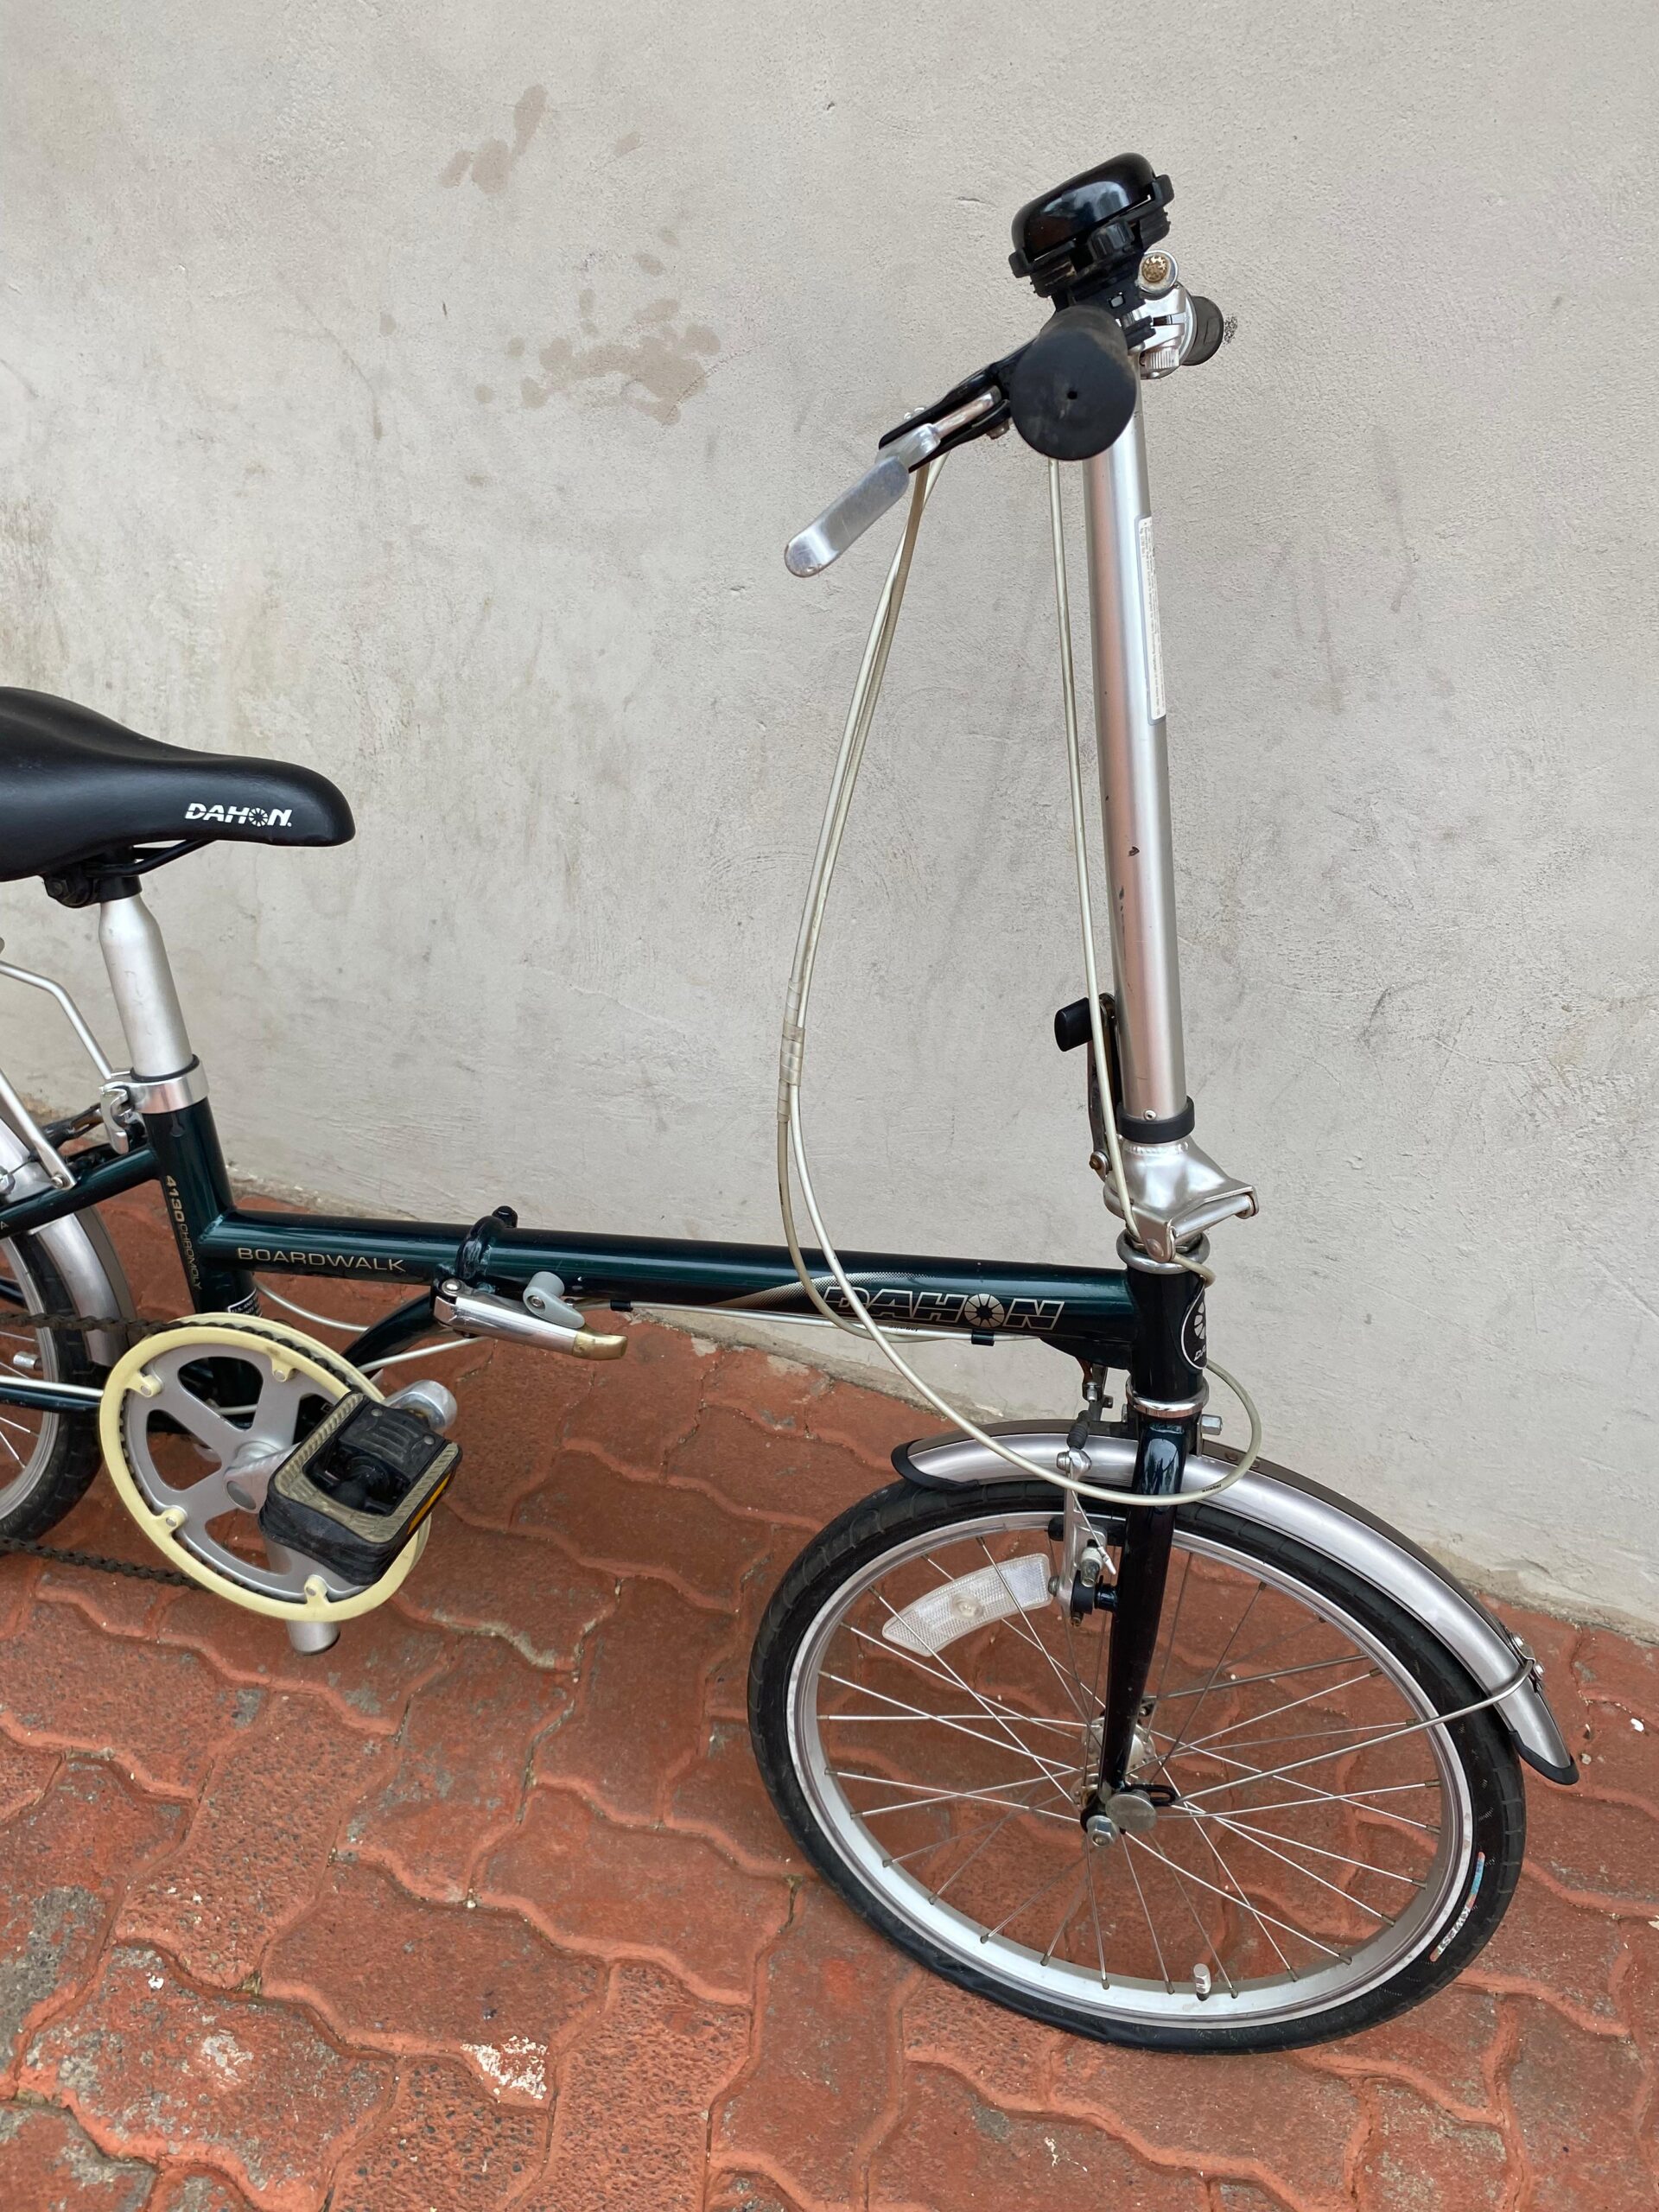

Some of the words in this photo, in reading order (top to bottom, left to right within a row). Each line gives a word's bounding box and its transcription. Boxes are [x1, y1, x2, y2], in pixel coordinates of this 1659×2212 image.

[165, 1174, 185, 1223] 4130
[179, 1224, 203, 1291] CHROMOLY
[238, 1247, 407, 1273] BOARDWALK
[823, 1286, 1065, 1331] DAHON
